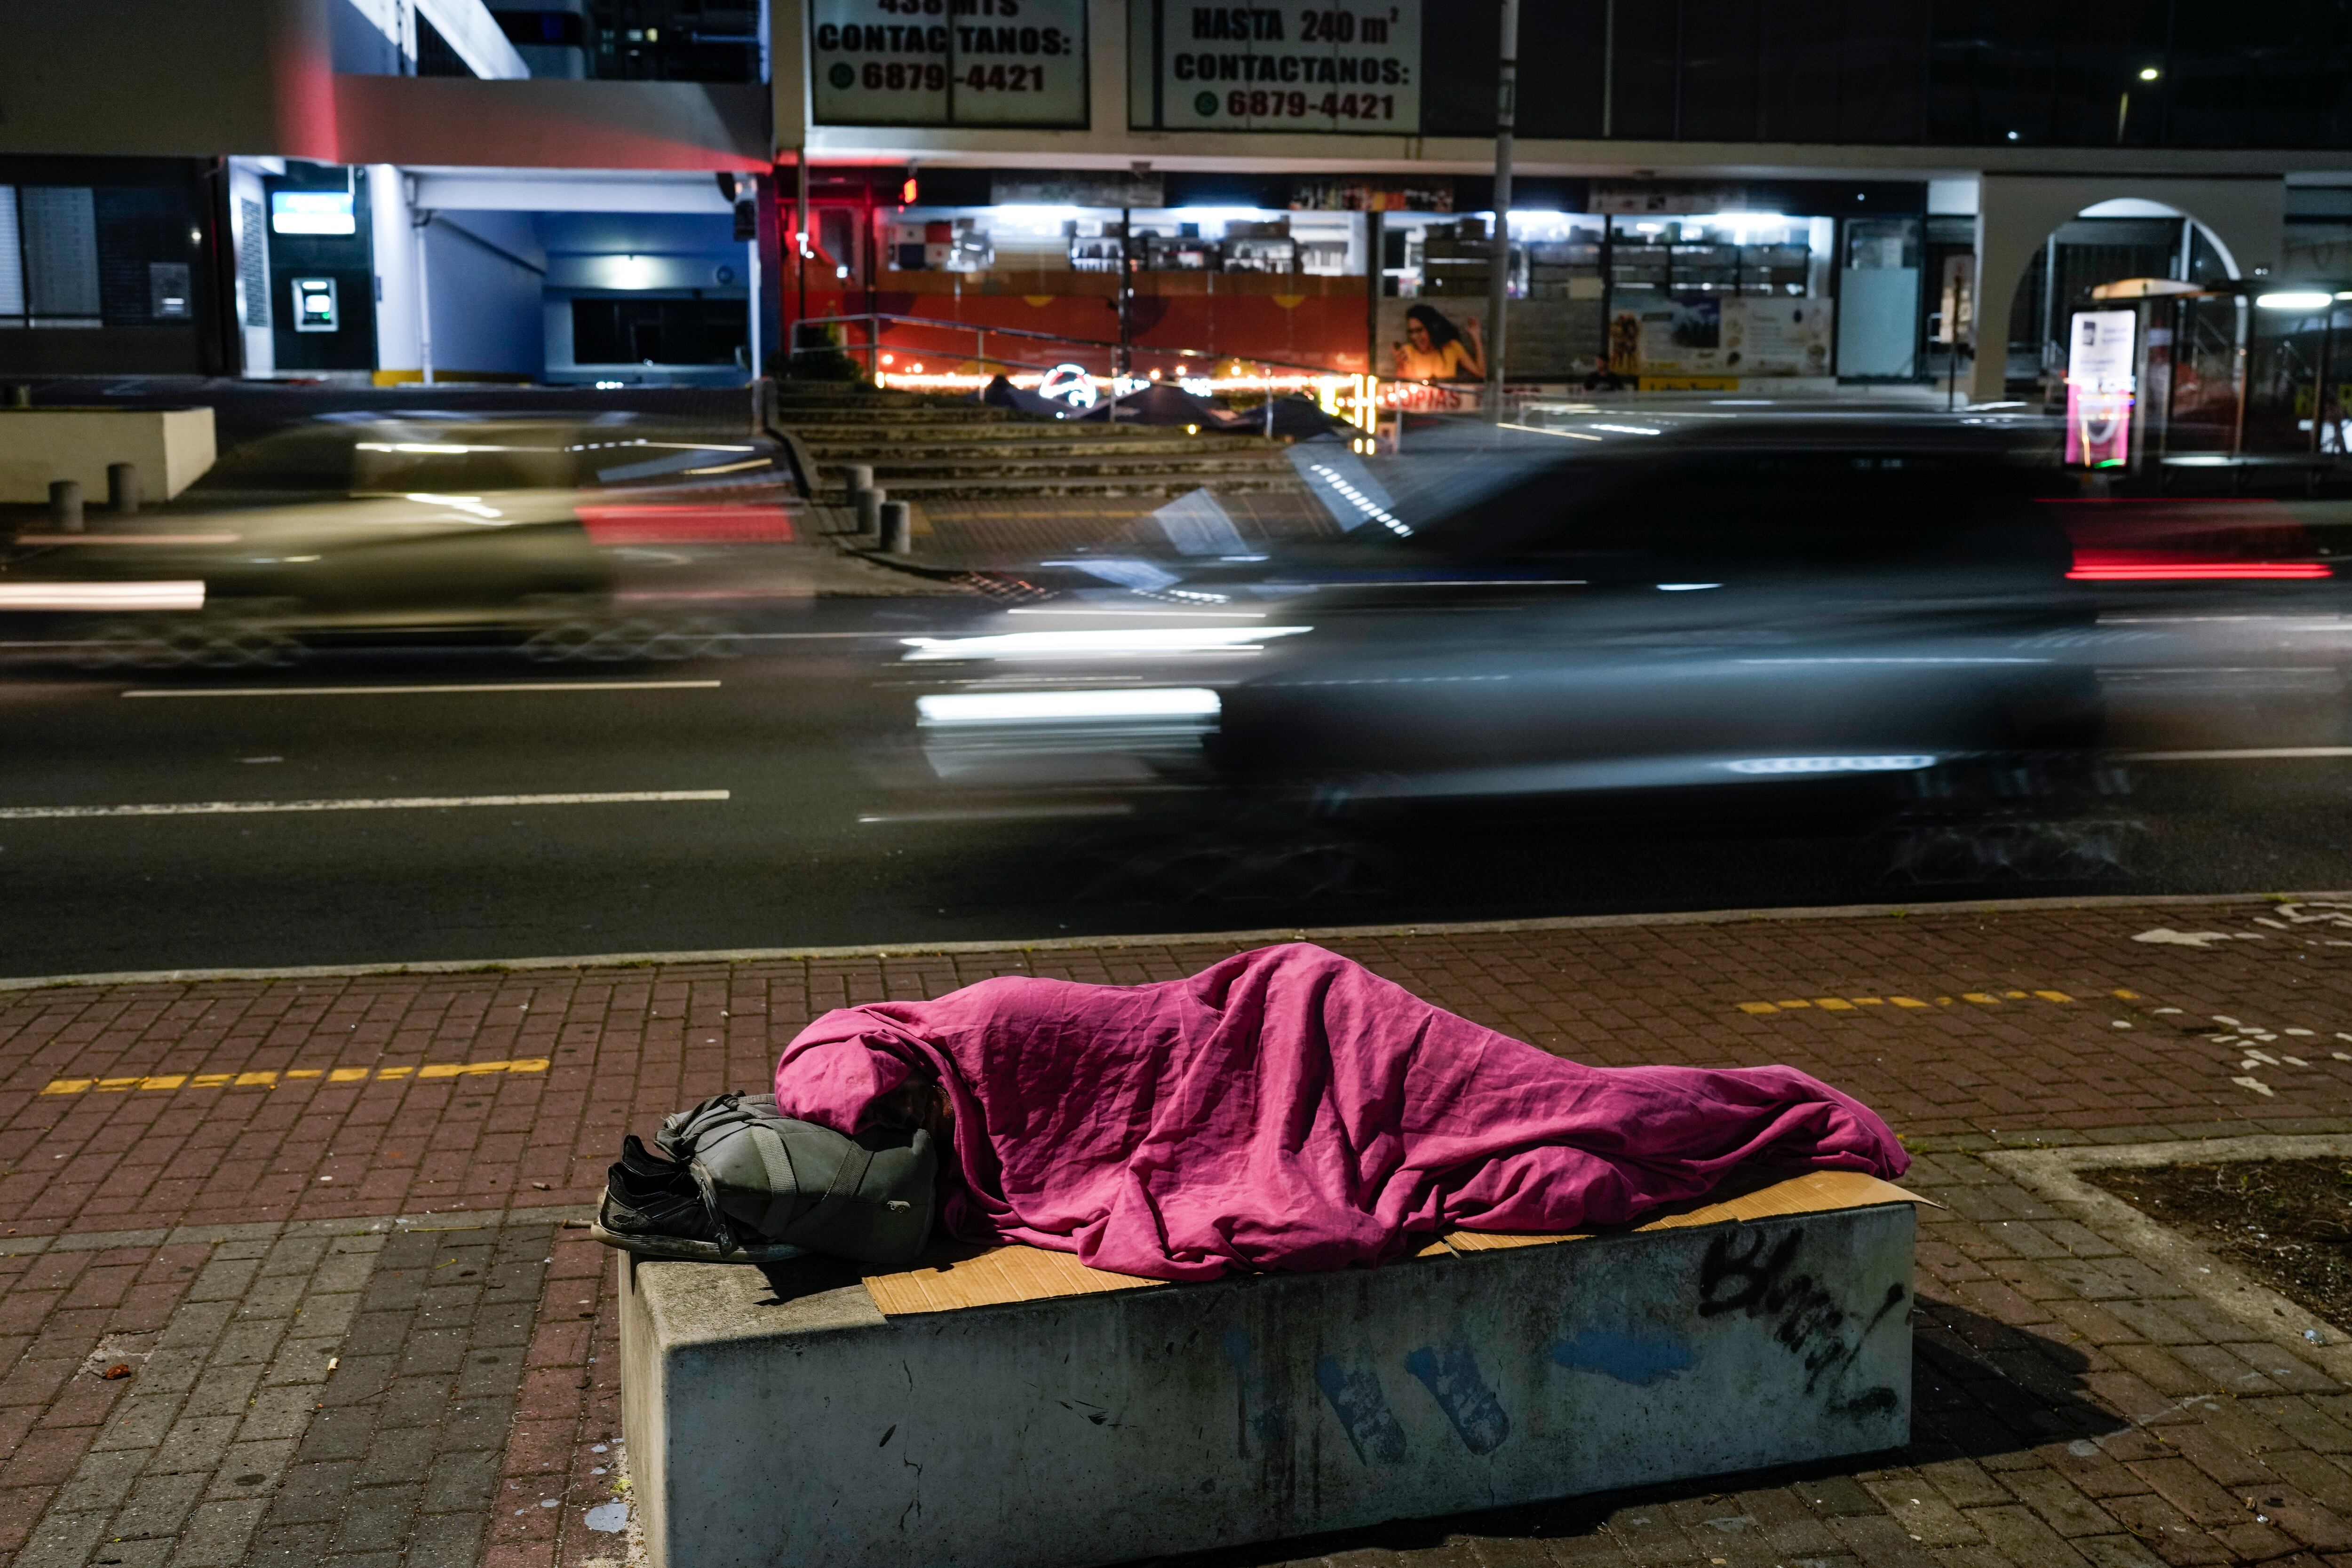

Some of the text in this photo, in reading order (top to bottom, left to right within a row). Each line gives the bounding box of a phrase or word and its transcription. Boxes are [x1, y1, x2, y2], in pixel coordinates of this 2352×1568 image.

[1192, 7, 1284, 40] HASTA
[1300, 10, 1354, 42] 240
[1175, 53, 1410, 85] CONTACTANOS:
[1227, 90, 1393, 120] 6879-4421
